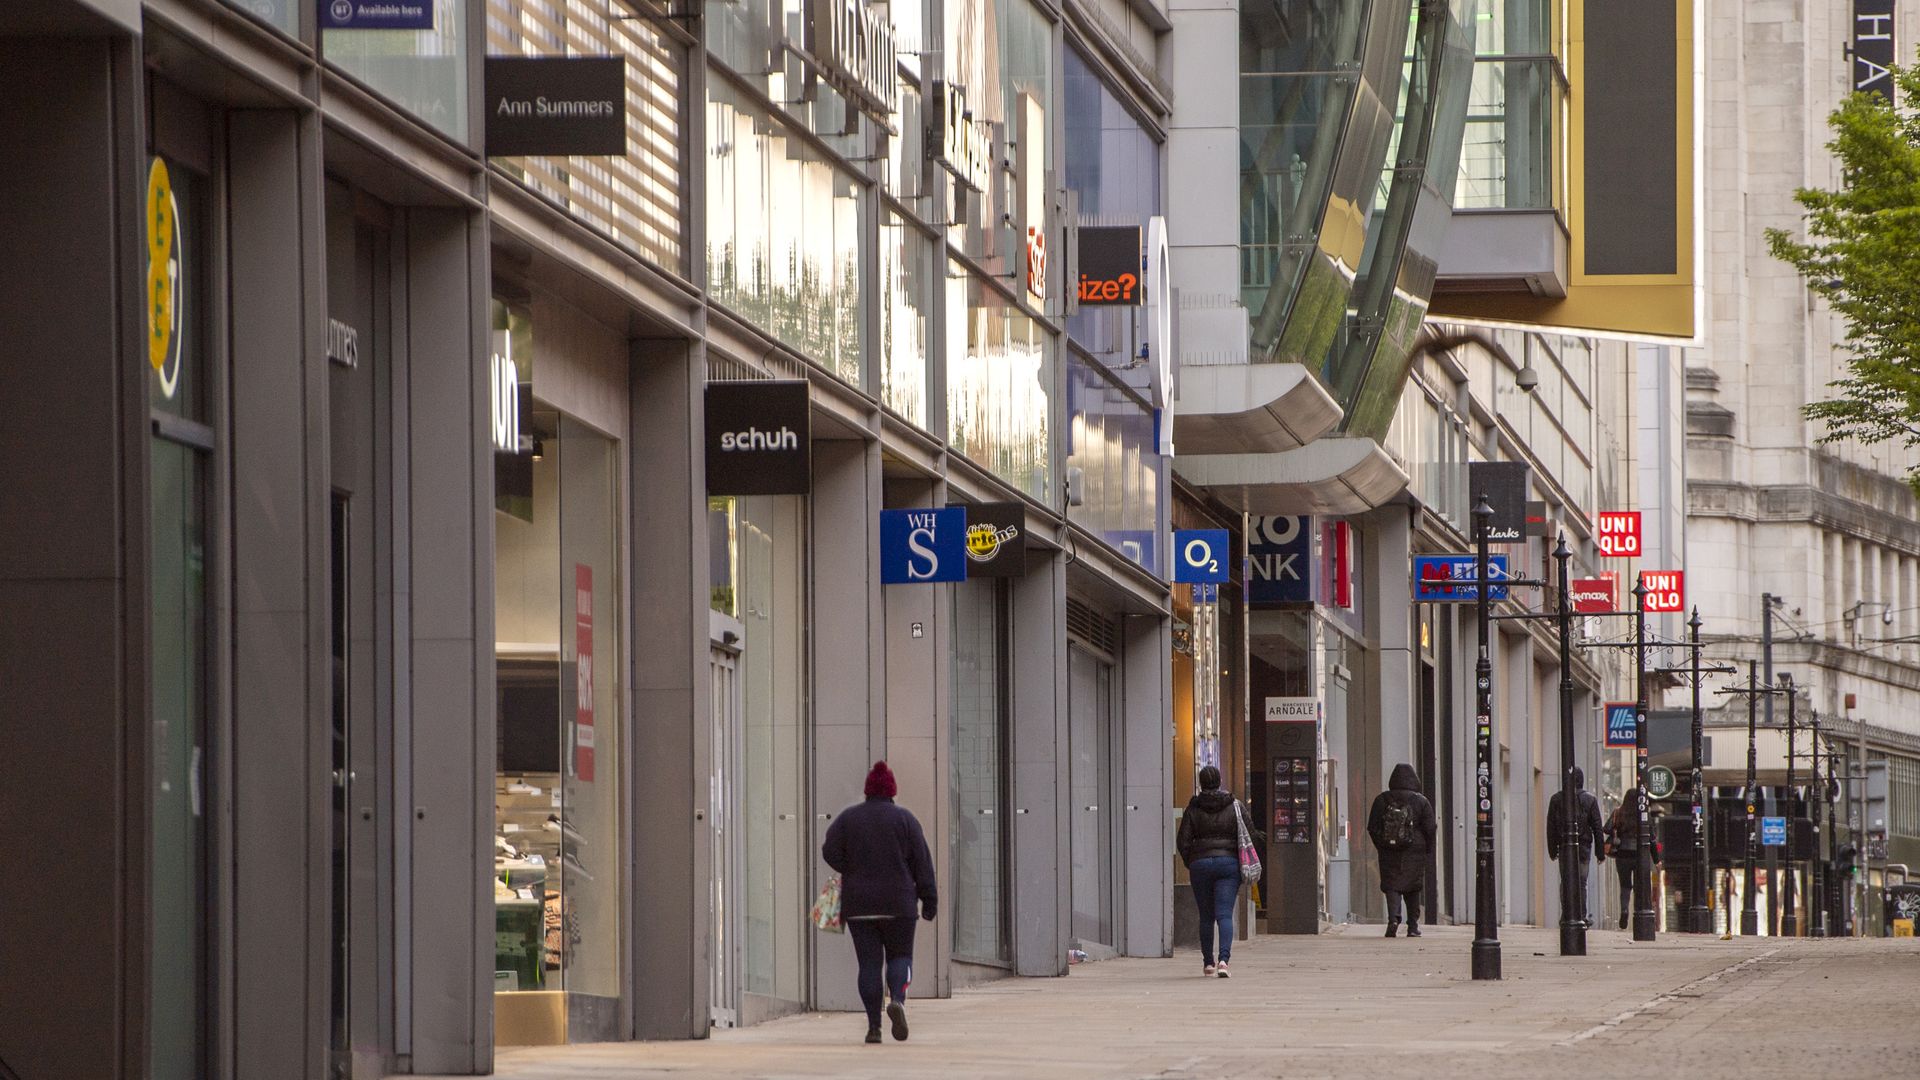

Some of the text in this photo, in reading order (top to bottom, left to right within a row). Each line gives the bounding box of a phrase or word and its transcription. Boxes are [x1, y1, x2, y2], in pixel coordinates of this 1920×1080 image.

[357, 4, 400, 15] Available
[402, 5, 423, 15] here
[497, 96, 614, 114] Ann Summers
[720, 426, 797, 450] schuh
[907, 513, 936, 528] WH
[1600, 517, 1633, 533] UNI
[1477, 526, 1519, 539] larks
[908, 528, 938, 579] S
[1600, 536, 1637, 554] QLO
[1185, 540, 1218, 572] O2
[1646, 575, 1676, 590] UNI
[1646, 592, 1680, 610] QLO
[1269, 706, 1313, 715] ARNDALE
